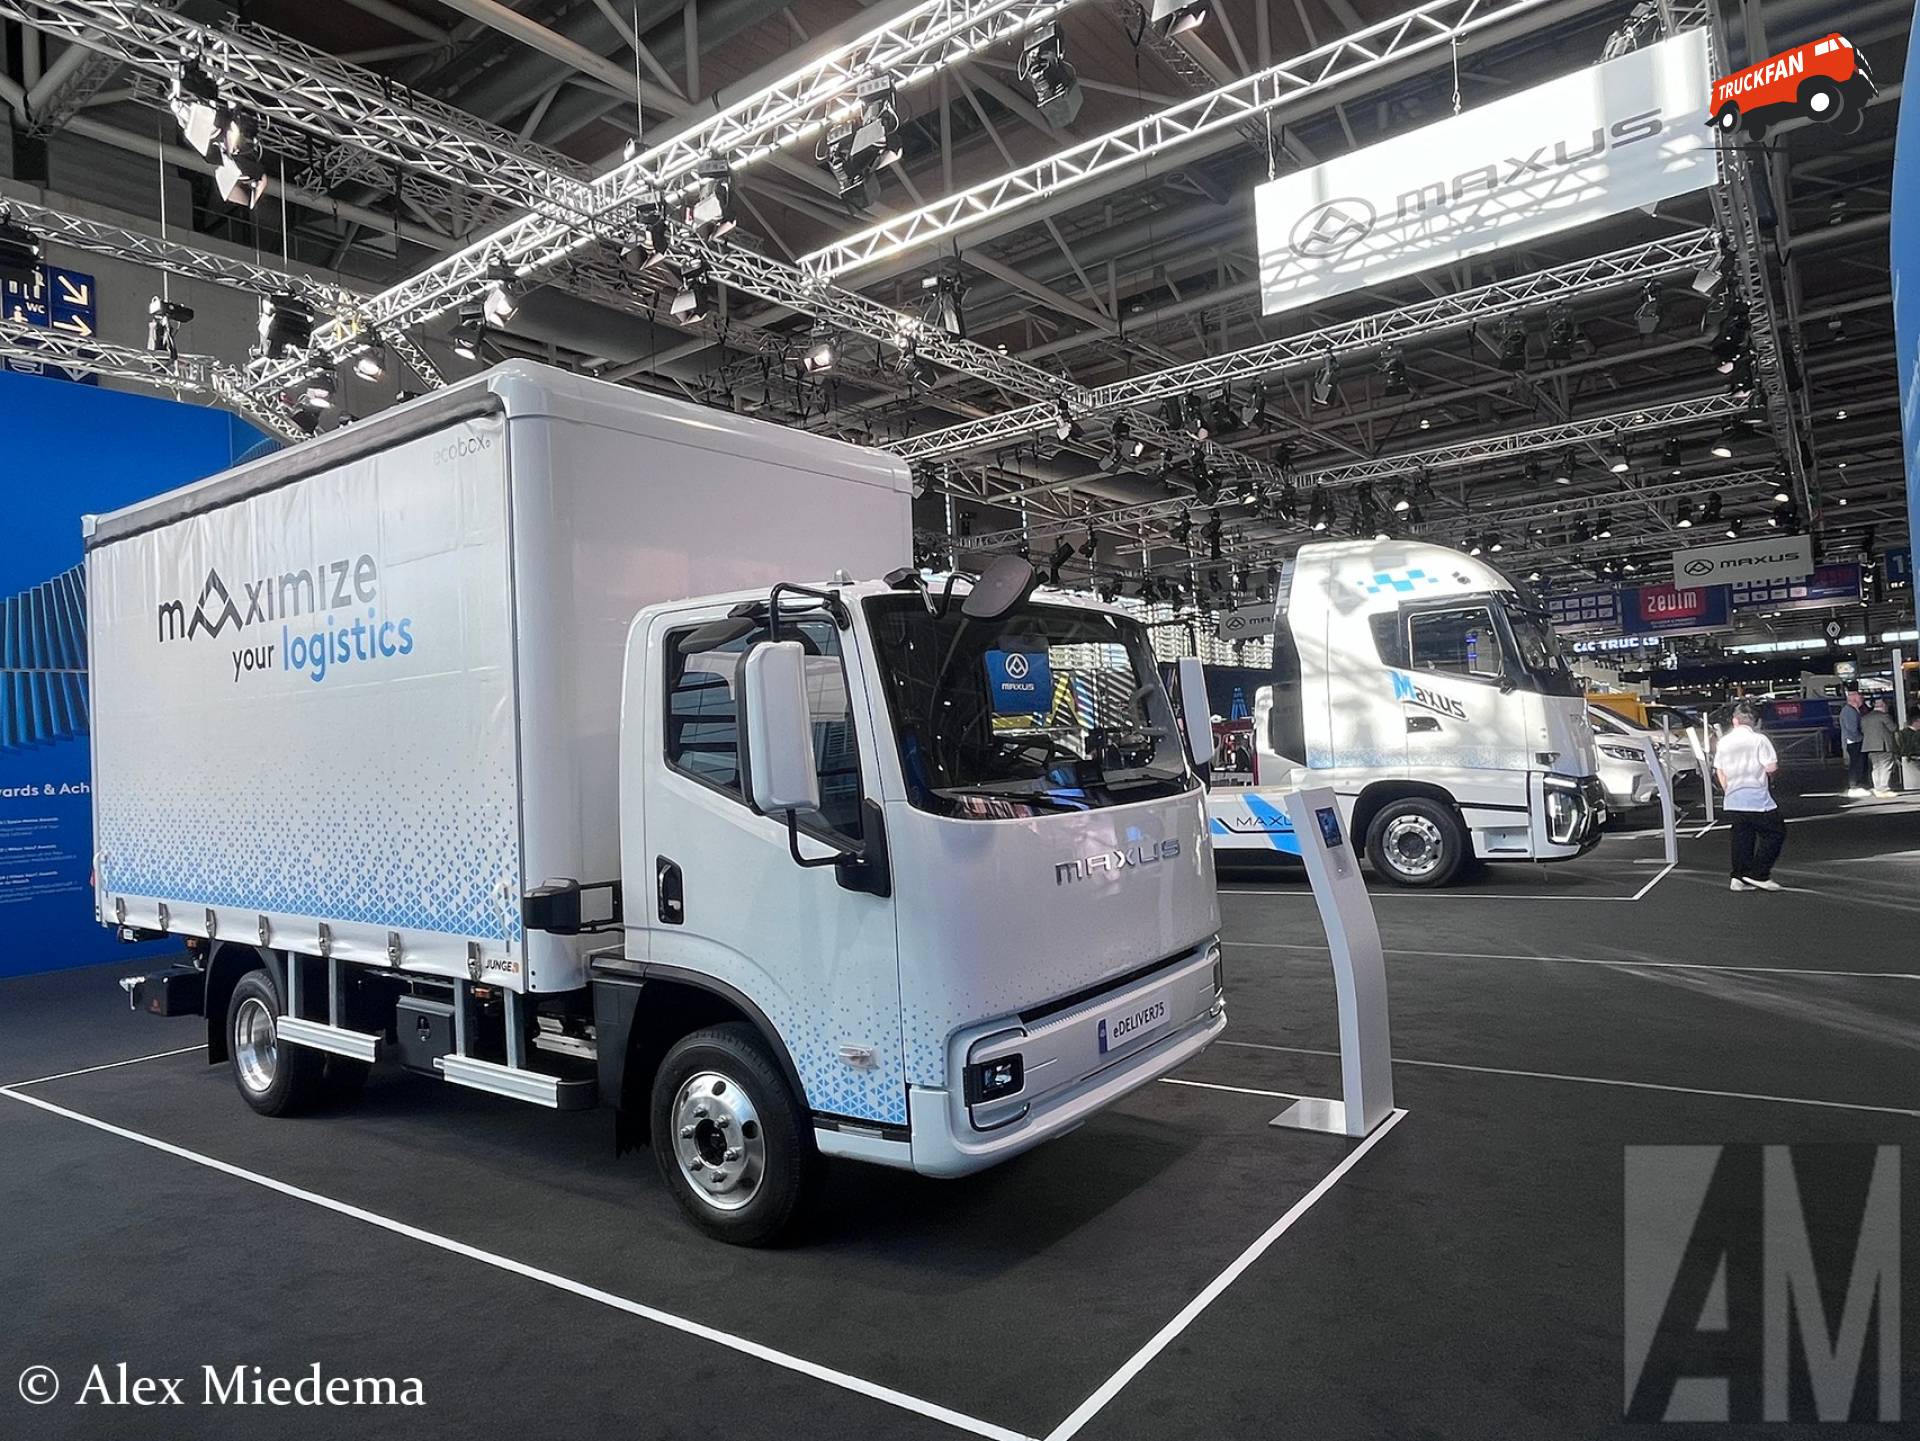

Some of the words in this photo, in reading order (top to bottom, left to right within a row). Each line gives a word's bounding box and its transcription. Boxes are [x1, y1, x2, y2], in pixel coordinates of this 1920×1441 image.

[1396, 108, 1663, 208] MAXUS
[26, 302, 45, 314] WC
[1720, 552, 1800, 569] MAXUS
[232, 645, 274, 682] your
[282, 607, 414, 682] logistics
[1001, 682, 1035, 691] MAXUS
[0, 784, 39, 797] ards
[44, 783, 55, 796] &
[1055, 839, 1181, 886] MAXUS
[485, 959, 512, 972] JUNGE
[1113, 1001, 1165, 1038] eDELIVER75
